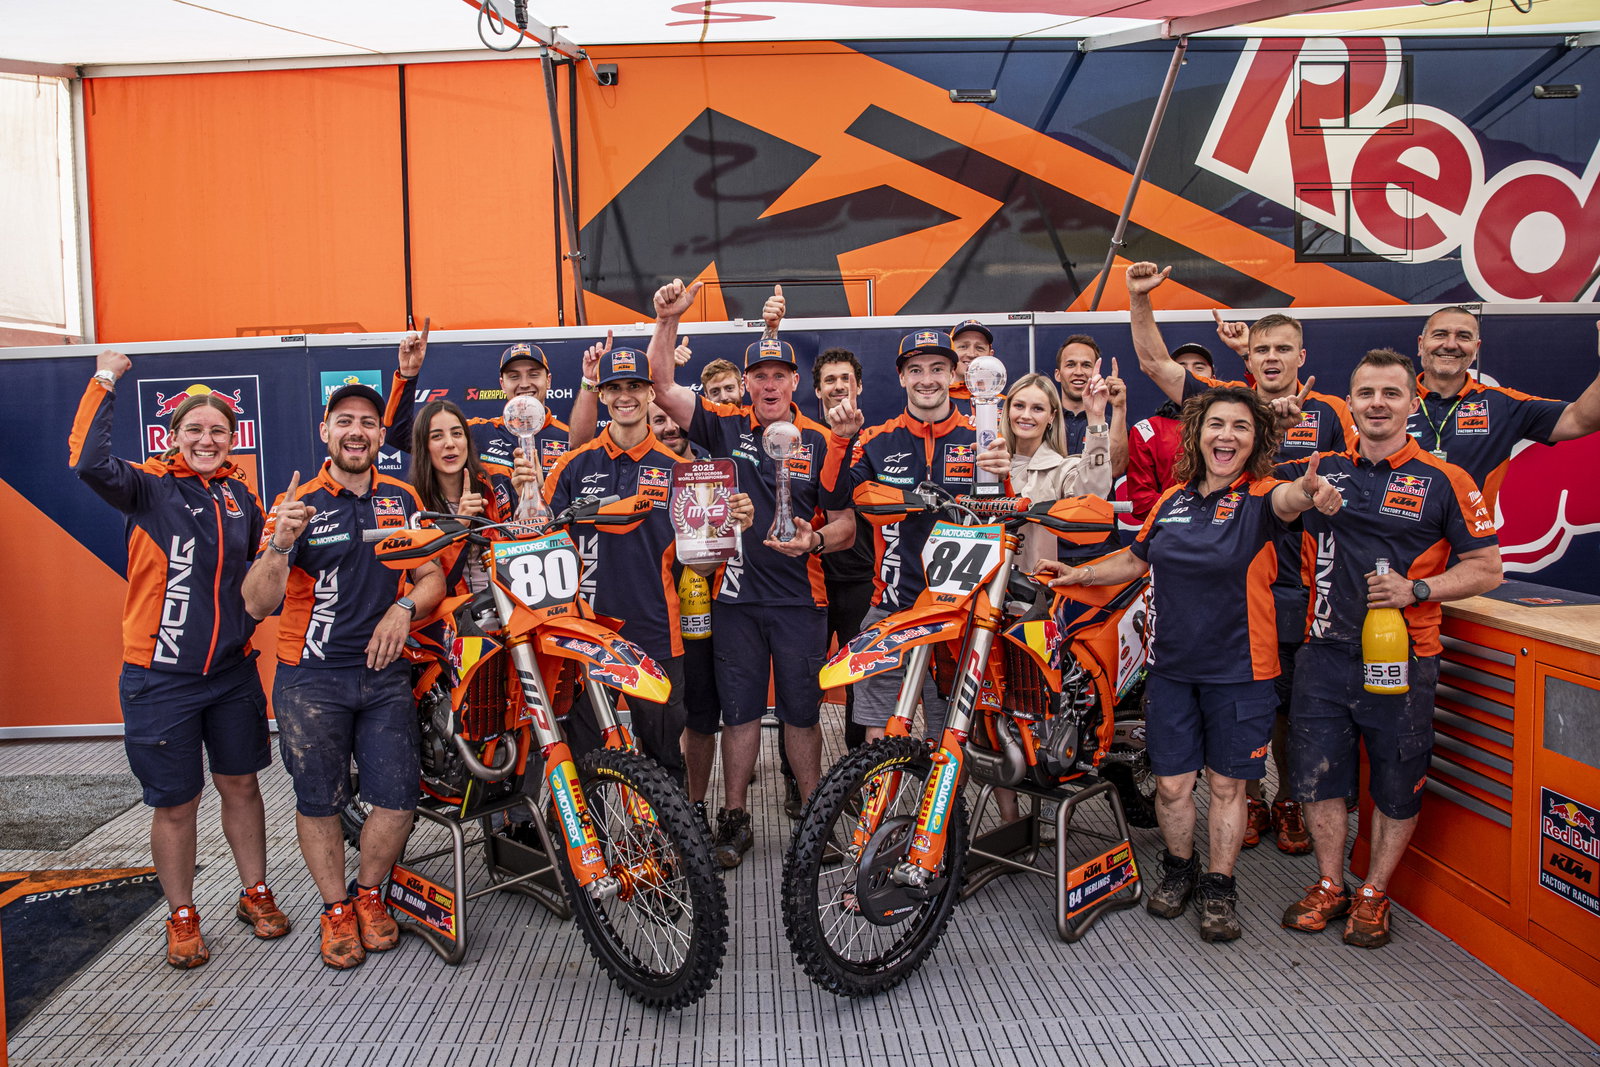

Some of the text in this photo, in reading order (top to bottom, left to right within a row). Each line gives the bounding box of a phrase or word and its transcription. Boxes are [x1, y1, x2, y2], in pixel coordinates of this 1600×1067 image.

[1195, 38, 1600, 302] Red
[479, 389, 507, 399] AKRAPOV
[546, 389, 573, 398] ROH
[883, 466, 908, 474] WP
[949, 466, 971, 474] KTM
[639, 477, 668, 487] Red Bull
[886, 476, 914, 484] MOTOREX
[581, 486, 606, 494] WP
[642, 489, 664, 497] KTM
[1388, 482, 1425, 496] Red Bull
[633, 499, 650, 512] KTM
[1389, 496, 1418, 508] KTM
[375, 506, 389, 514] Red
[687, 504, 725, 518] MX2
[1381, 506, 1419, 519] FACTORY RACING
[312, 523, 340, 535] WP
[382, 518, 402, 527] KTM
[316, 533, 349, 545] MOTOREX
[941, 528, 977, 538] MOTOREX
[381, 536, 412, 550] KTM
[506, 537, 572, 555] MOTOREX MX2
[926, 540, 992, 591] 84
[509, 549, 578, 606] 80
[936, 594, 957, 603] KTM
[547, 605, 568, 616] KTM
[891, 626, 931, 643] Red Bull
[566, 639, 582, 650] Red
[580, 643, 601, 656] Bull
[597, 767, 638, 790] PIRELLI
[935, 762, 957, 814] MOTOREX
[917, 766, 940, 826] PIRELLI
[556, 789, 581, 844] MOTOREX
[1543, 816, 1600, 860] Red Bull
[1083, 862, 1102, 880] KTM
[1549, 852, 1593, 884] KTM
[24, 874, 158, 904] ADY TO RACE
[406, 877, 424, 893] KTM
[1541, 872, 1600, 911] FACTORY RACING
[390, 884, 404, 901] 80
[404, 893, 427, 911] ADAMO
[1068, 887, 1082, 908] 84
